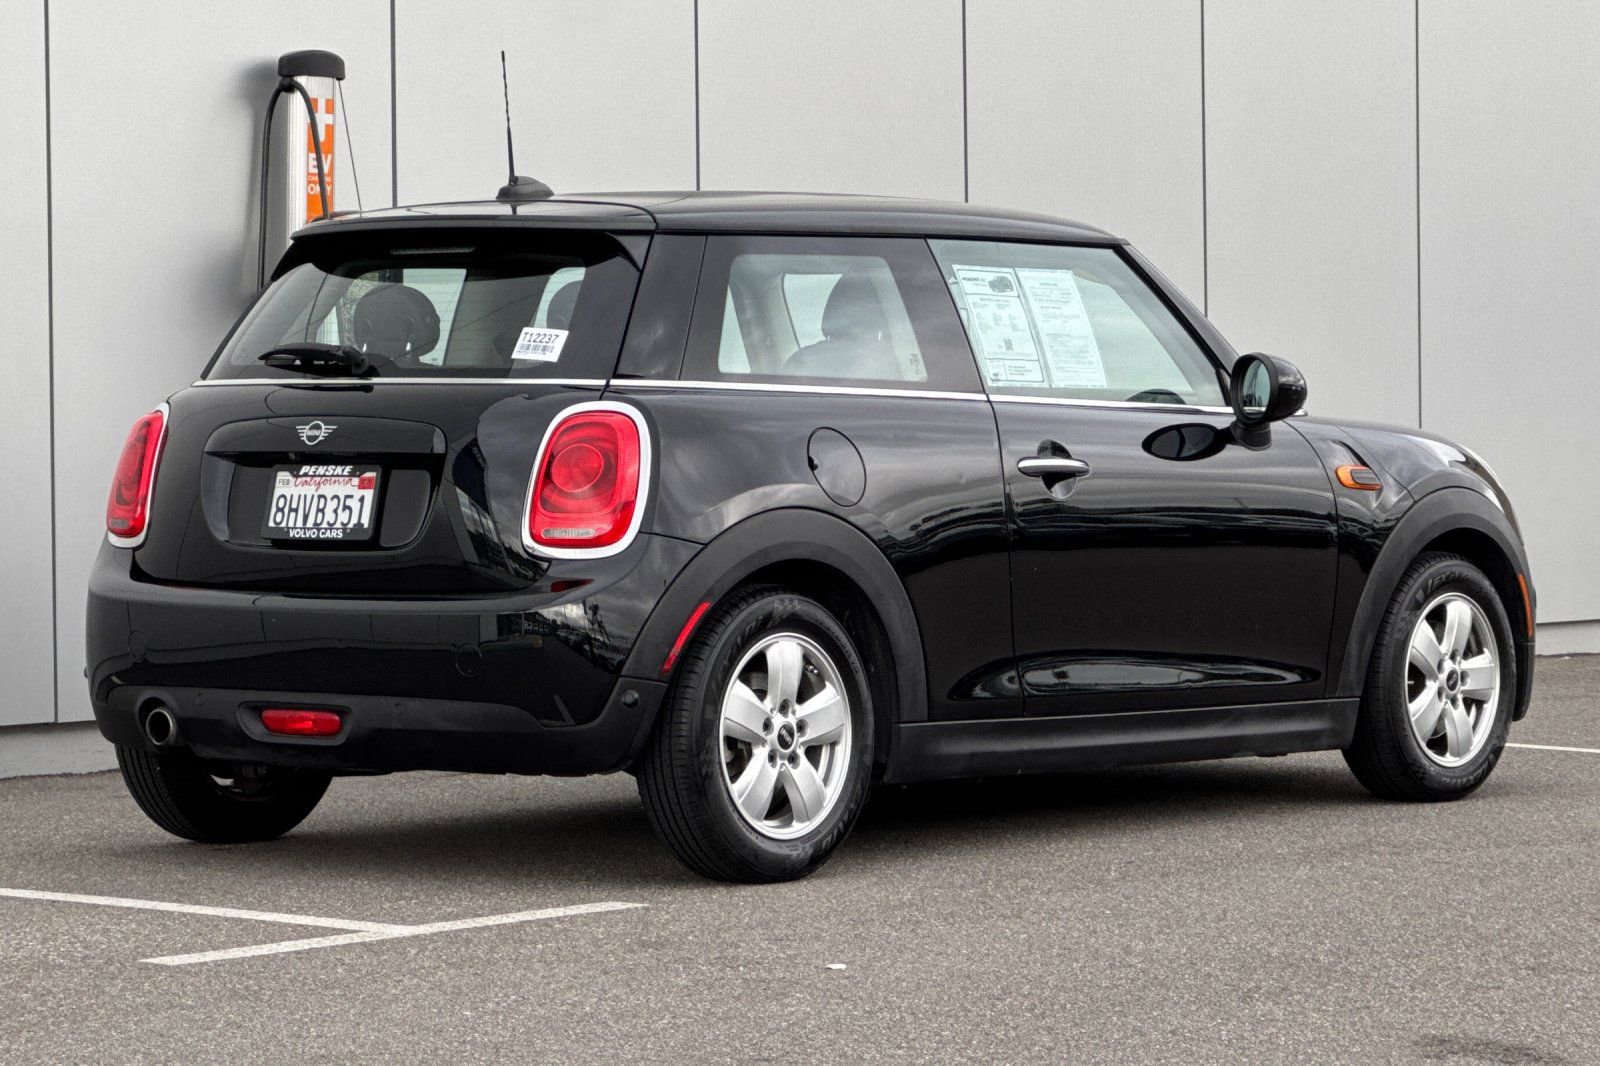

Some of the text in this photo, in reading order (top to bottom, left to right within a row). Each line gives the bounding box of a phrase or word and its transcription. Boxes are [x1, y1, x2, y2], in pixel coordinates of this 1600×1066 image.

[522, 332, 560, 344] T12237
[299, 465, 354, 476] PENSKE
[294, 476, 353, 492] California
[272, 493, 366, 529] 8HVB351
[288, 528, 344, 538] VOLVO CARS
